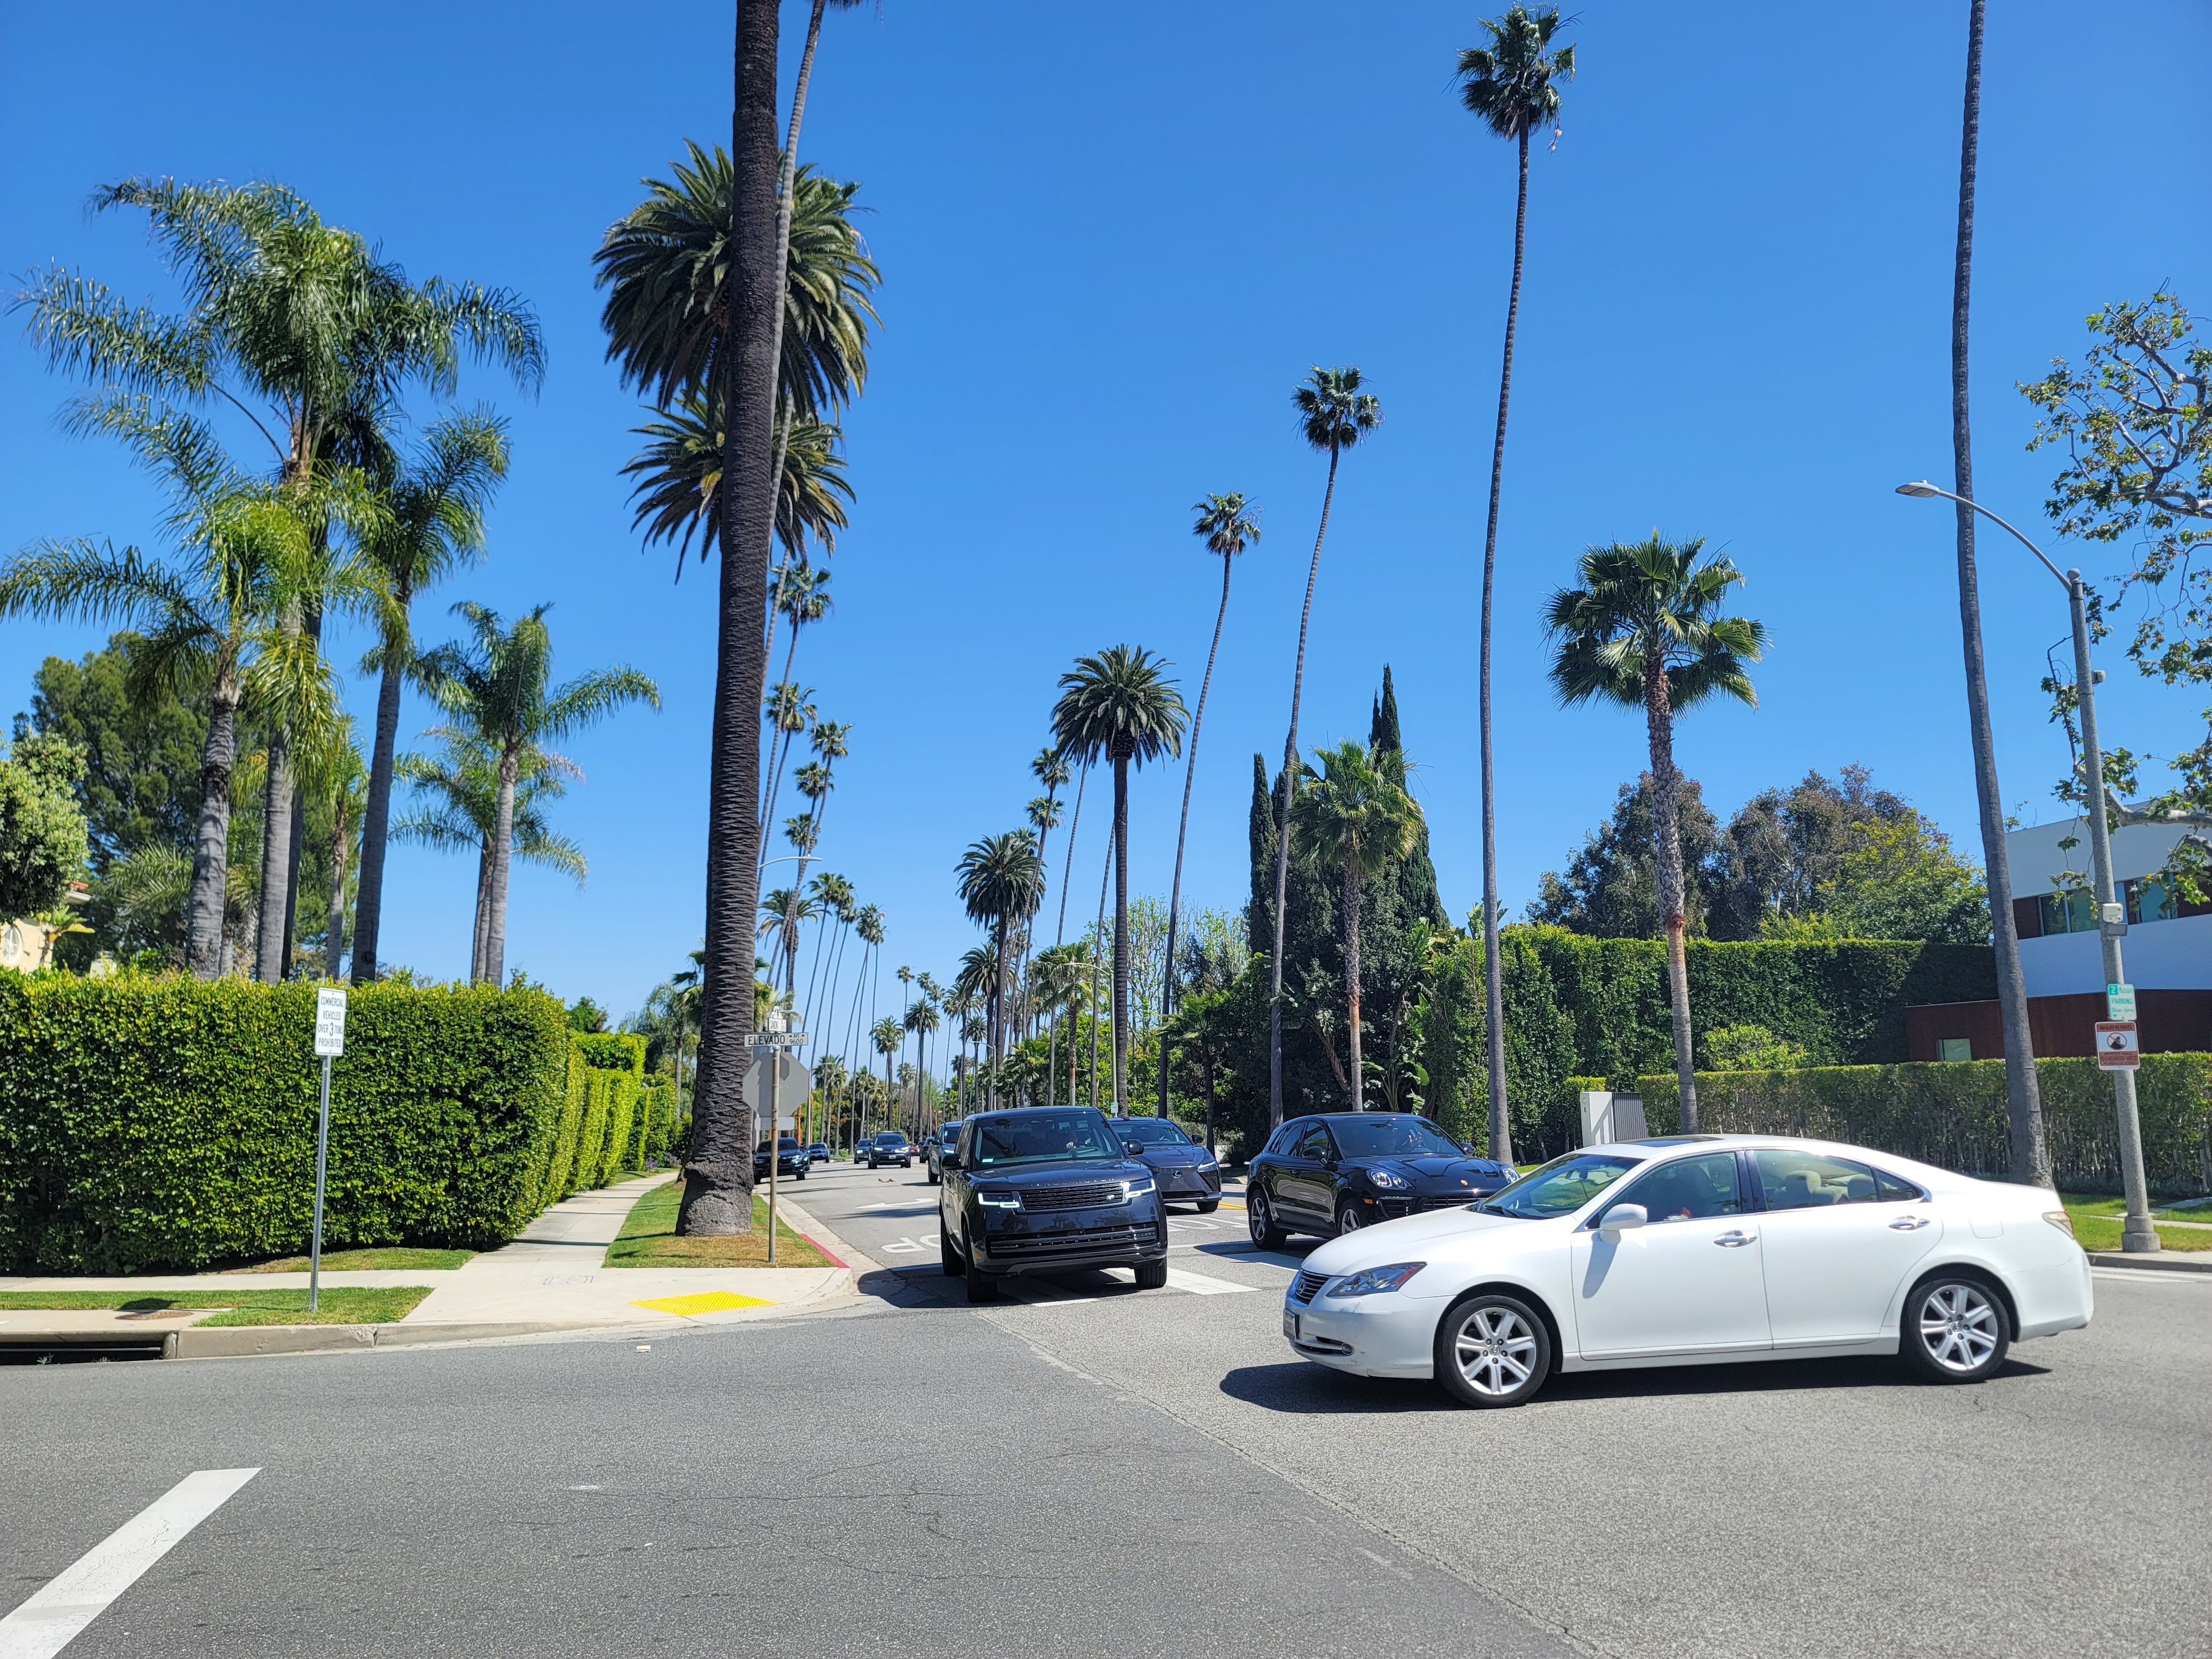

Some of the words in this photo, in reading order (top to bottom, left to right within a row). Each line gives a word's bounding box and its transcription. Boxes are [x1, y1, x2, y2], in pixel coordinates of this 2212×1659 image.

[2110, 985, 2116, 994] 2
[321, 996, 343, 1007] COMMERCIAL
[323, 1010, 341, 1020] VEHICLES
[318, 1024, 328, 1033] OVER
[329, 1022, 333, 1036] 3
[318, 1037, 341, 1048] PROHIBITED
[748, 1035, 785, 1045] ELEVADO
